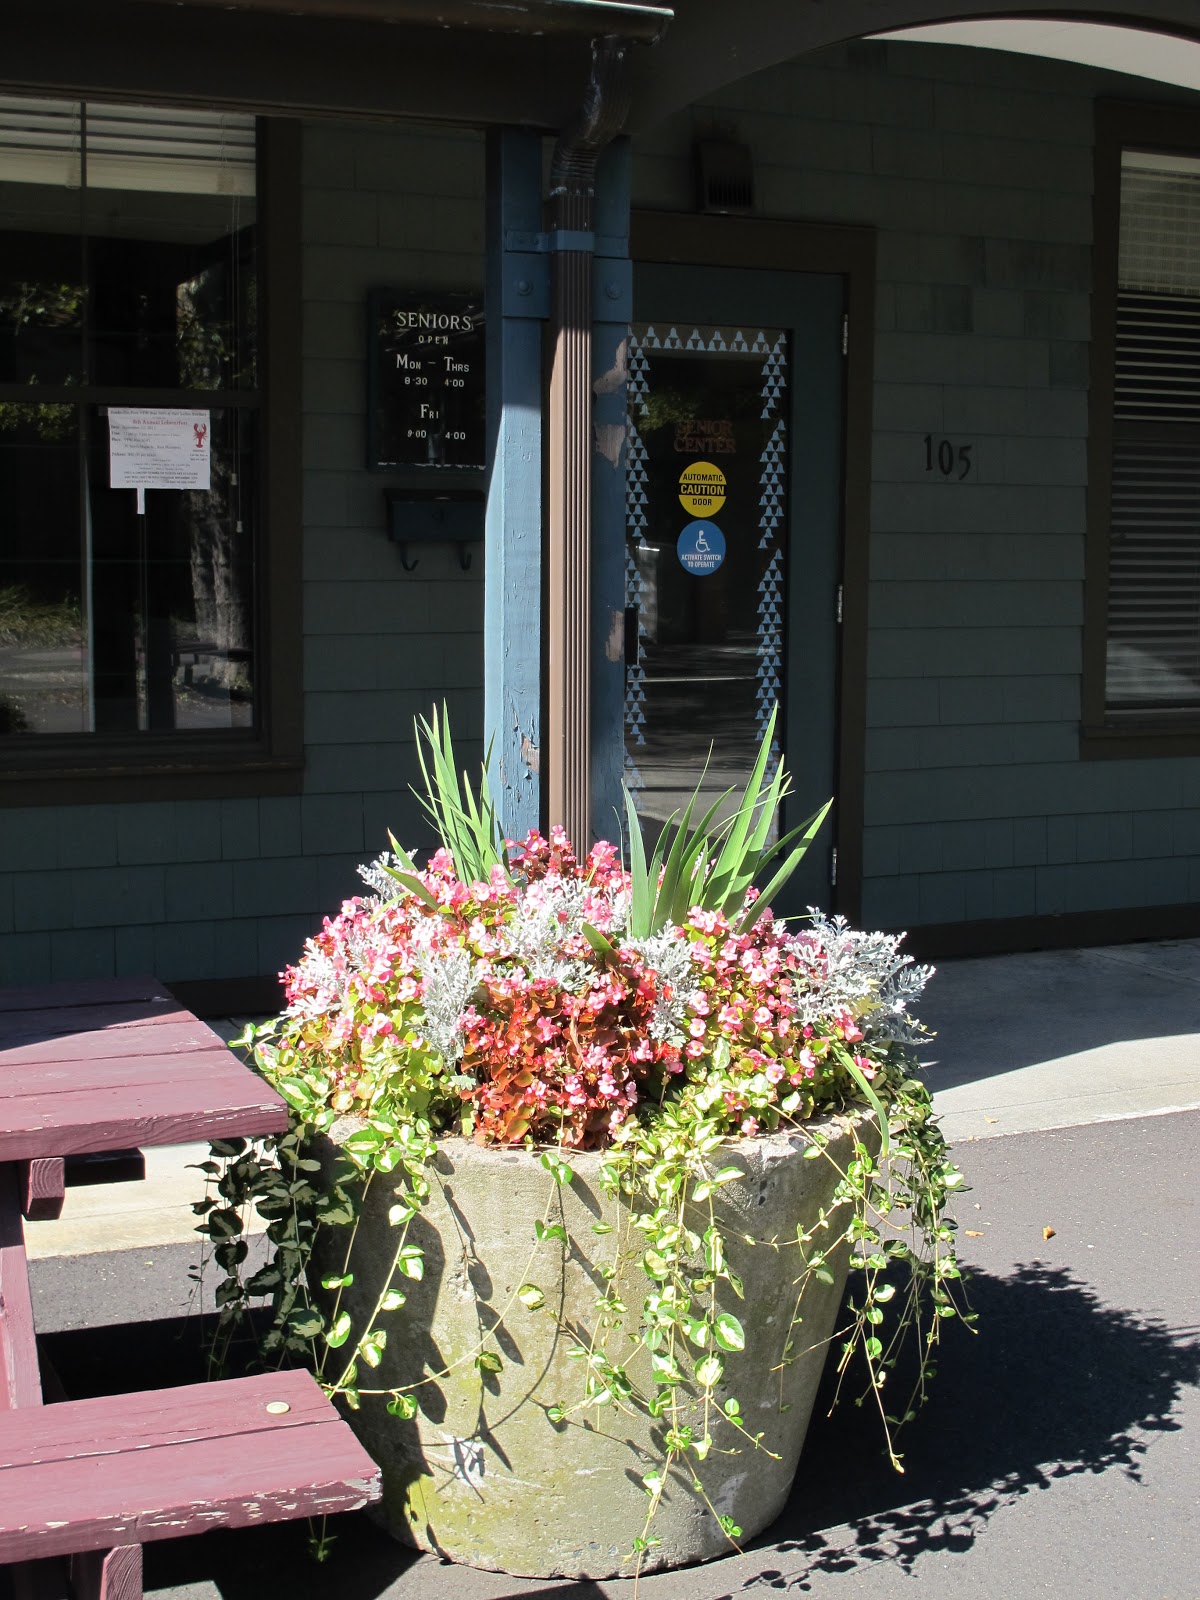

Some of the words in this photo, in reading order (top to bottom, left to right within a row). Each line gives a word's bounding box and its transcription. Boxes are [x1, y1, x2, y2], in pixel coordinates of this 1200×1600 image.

[396, 311, 472, 331] SENIORS
[418, 335, 449, 345] OPEN
[674, 437, 736, 453] CENTER
[923, 434, 972, 481] 105
[682, 473, 723, 482] AUTOMATIC
[680, 484, 725, 496] CAUTION
[692, 498, 712, 506] DOOR
